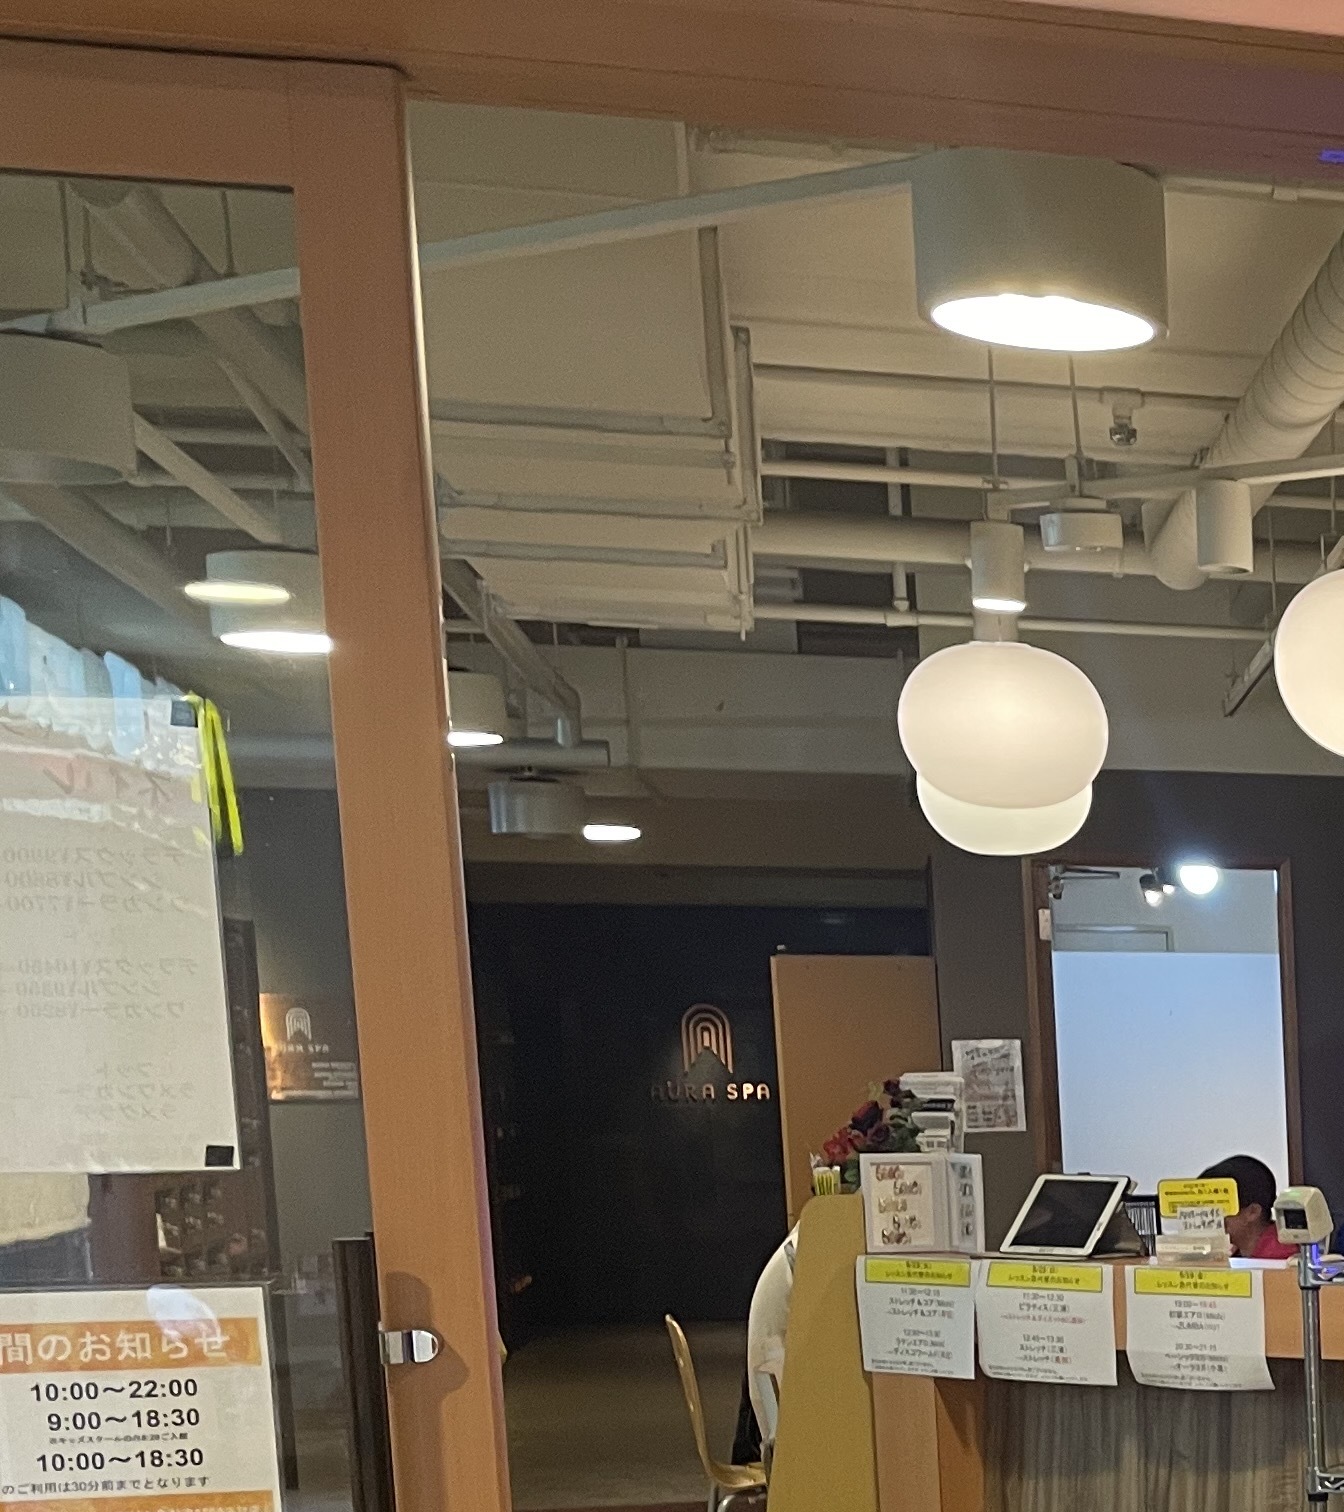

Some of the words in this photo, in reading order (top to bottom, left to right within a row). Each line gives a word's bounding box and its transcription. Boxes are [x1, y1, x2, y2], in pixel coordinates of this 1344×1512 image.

[726, 1082, 771, 1101] SPA
[0, 1331, 231, 1366] 間のお知らせ
[30, 1378, 198, 1402] 10:00～22:00
[47, 1408, 200, 1431] 9:00～18:30
[36, 1448, 204, 1472] 10:00～18:30
